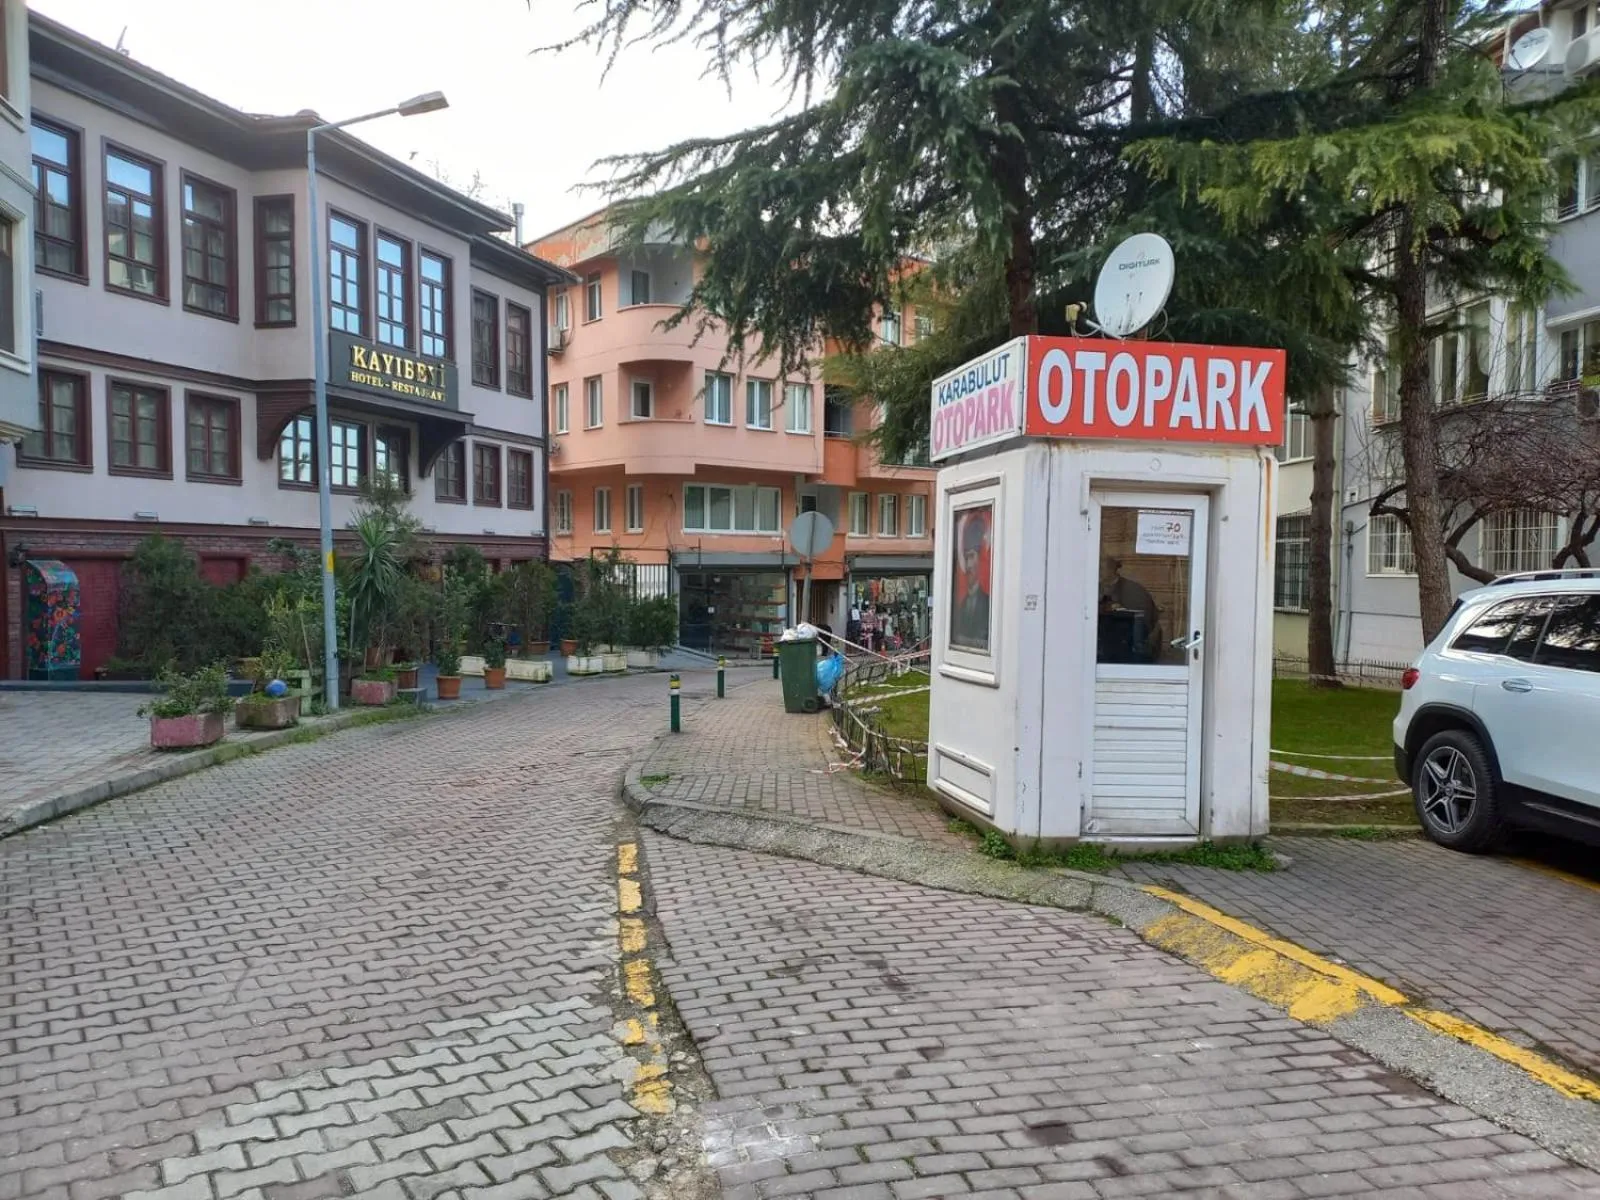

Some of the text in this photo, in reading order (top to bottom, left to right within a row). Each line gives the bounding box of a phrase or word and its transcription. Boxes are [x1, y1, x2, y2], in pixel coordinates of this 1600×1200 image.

[351, 371, 384, 388] HOTEL
[938, 353, 1010, 407] KARABULUT
[1038, 348, 1273, 433] OTOPARK
[933, 379, 1015, 454] OTOPARK
